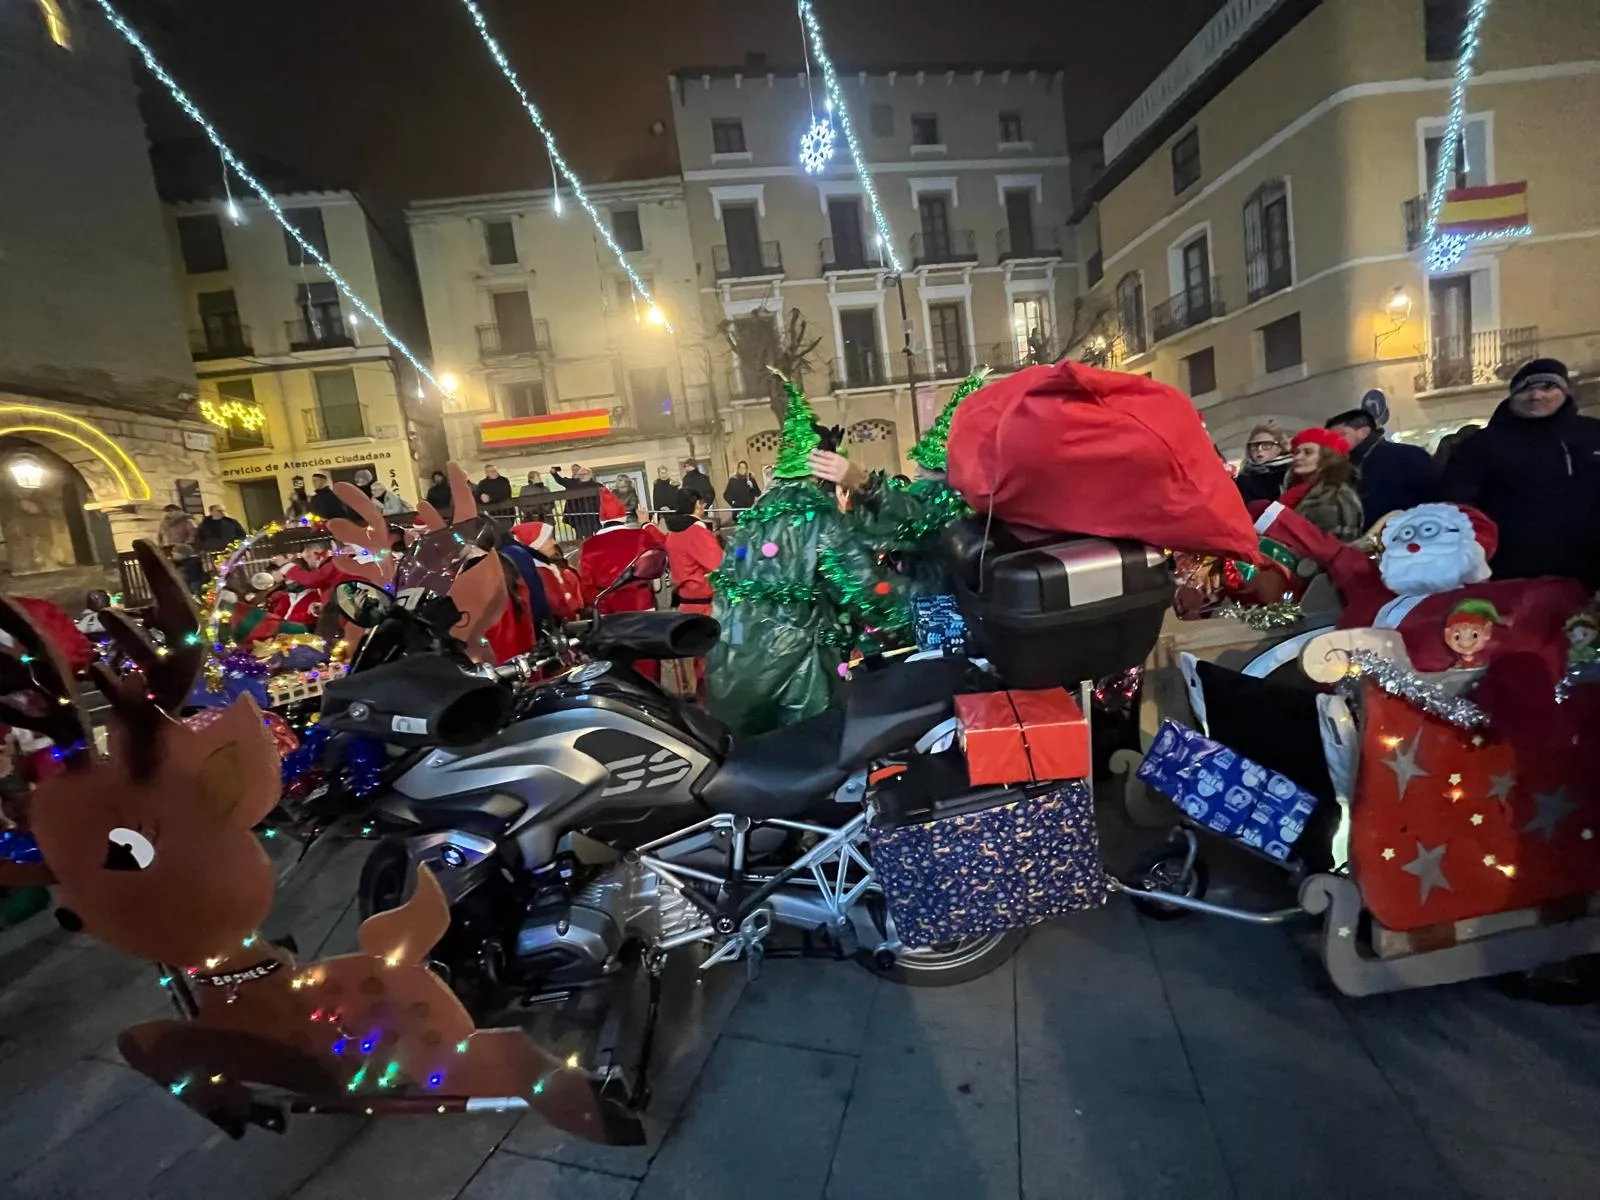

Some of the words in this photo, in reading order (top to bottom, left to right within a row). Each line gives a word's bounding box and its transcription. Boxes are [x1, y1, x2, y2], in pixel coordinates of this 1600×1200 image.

[222, 465, 262, 476] ervicio
[265, 464, 279, 472] de
[283, 457, 332, 469] Atención
[334, 451, 391, 464] Ciudadana
[600, 748, 691, 798] GS
